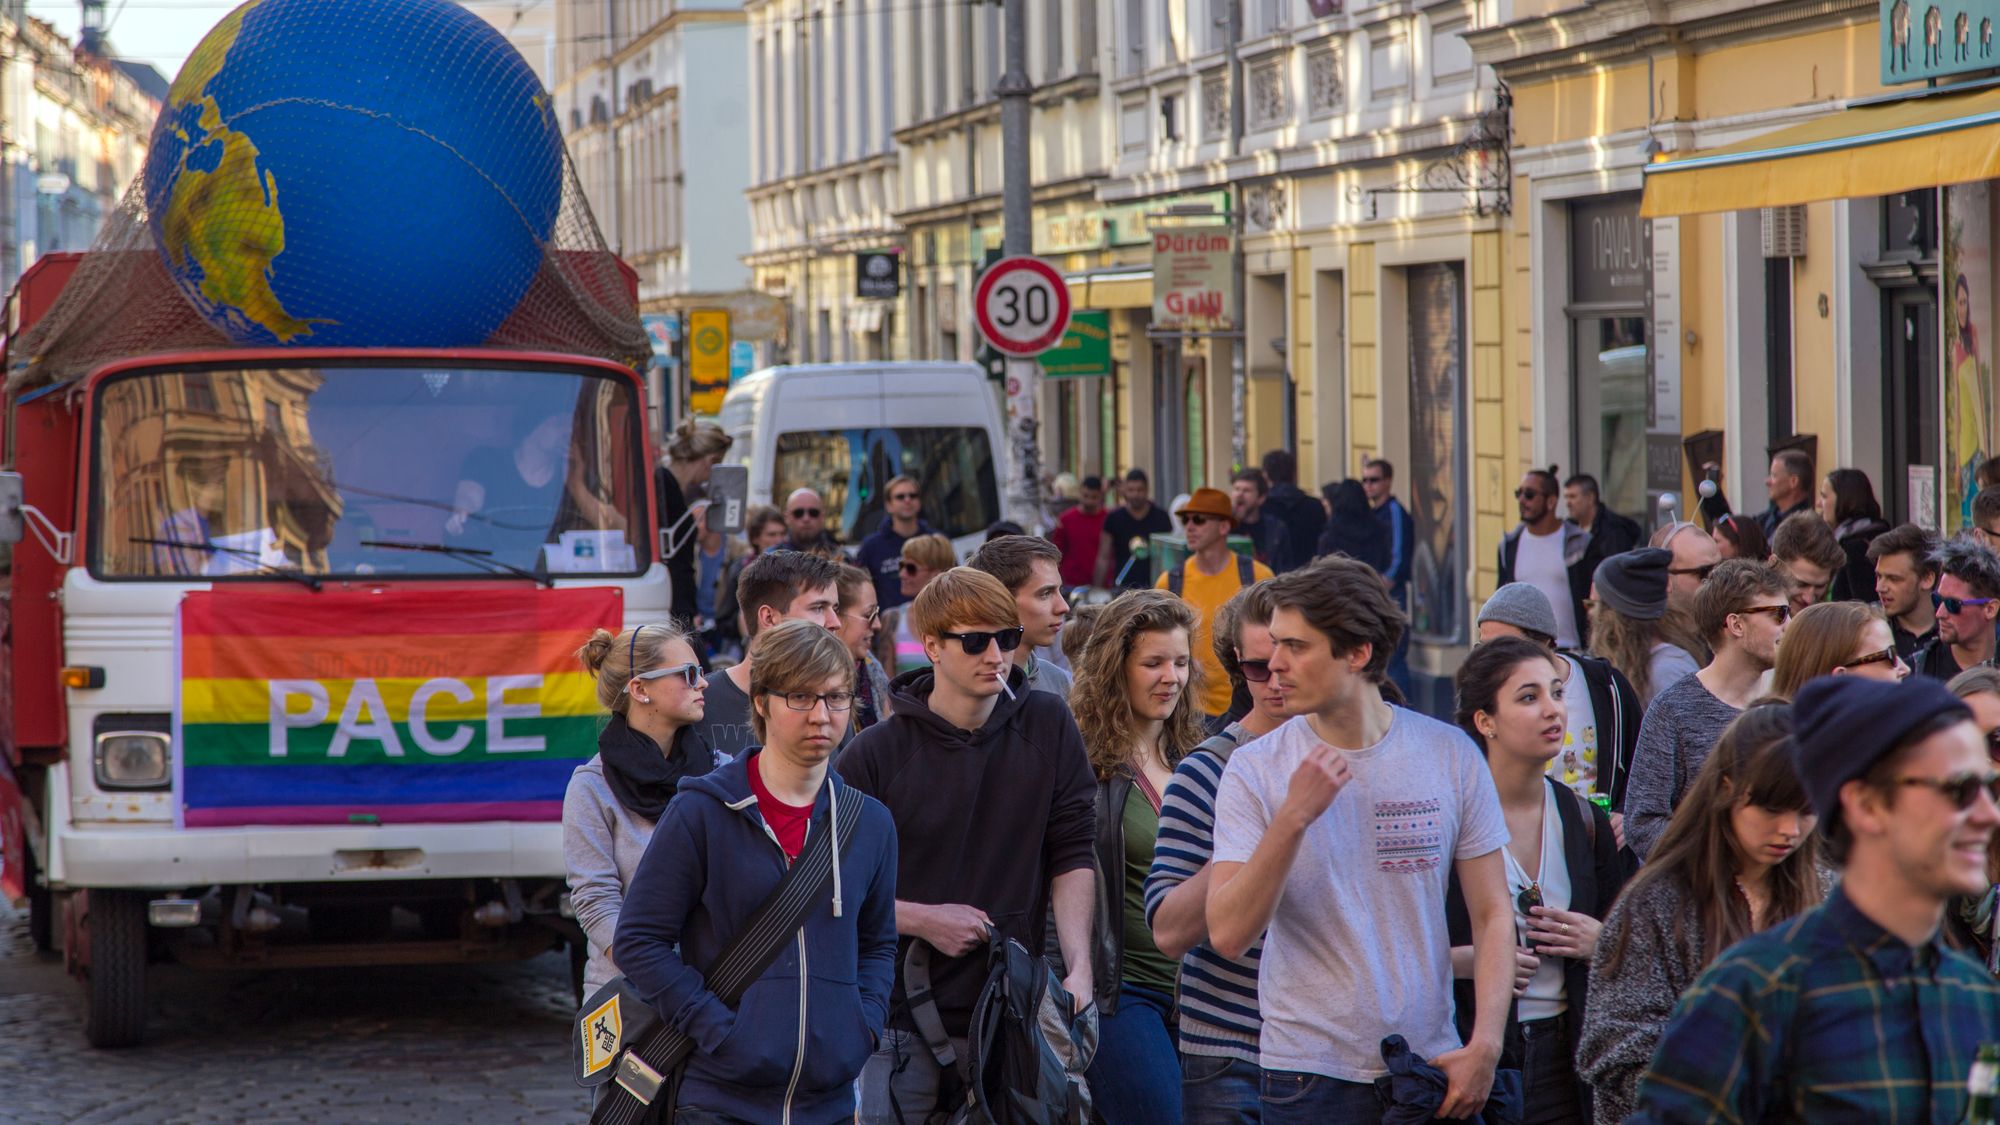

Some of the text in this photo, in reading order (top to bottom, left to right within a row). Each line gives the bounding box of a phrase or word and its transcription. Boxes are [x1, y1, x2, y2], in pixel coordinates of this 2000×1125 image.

[1155, 232, 1229, 253] Dürüm
[996, 285, 1049, 327] 30
[1166, 291, 1223, 315] Grill
[268, 674, 547, 757] PACE
